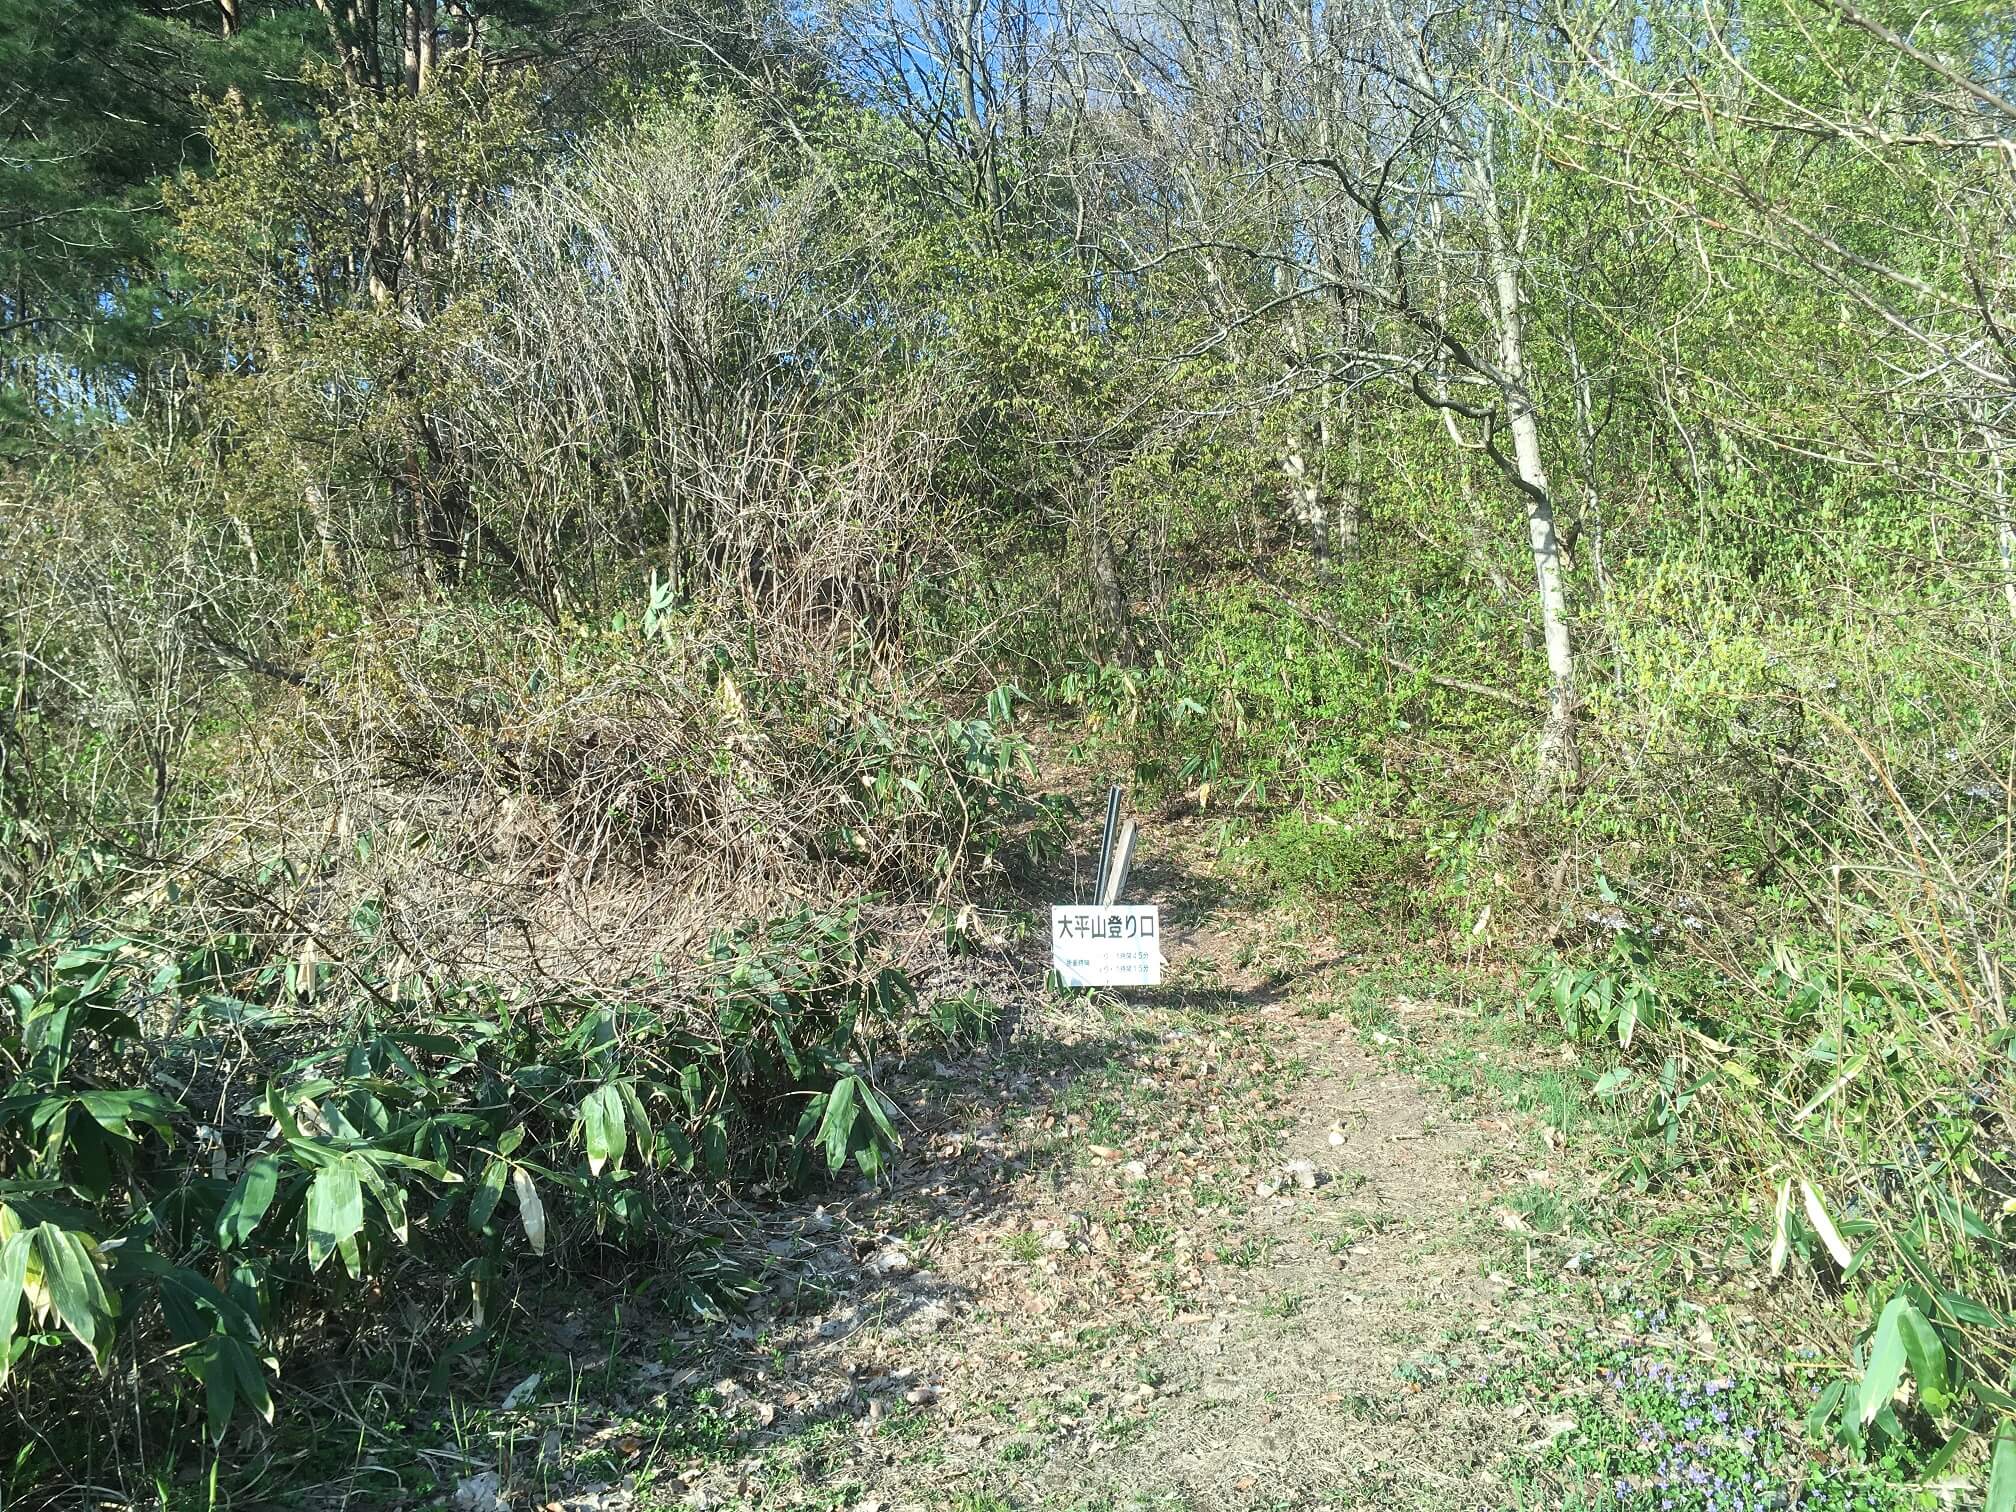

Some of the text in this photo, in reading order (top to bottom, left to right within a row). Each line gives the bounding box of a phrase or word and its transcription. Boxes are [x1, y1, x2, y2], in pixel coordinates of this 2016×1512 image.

[1058, 915, 1154, 939] 大平山登り口
